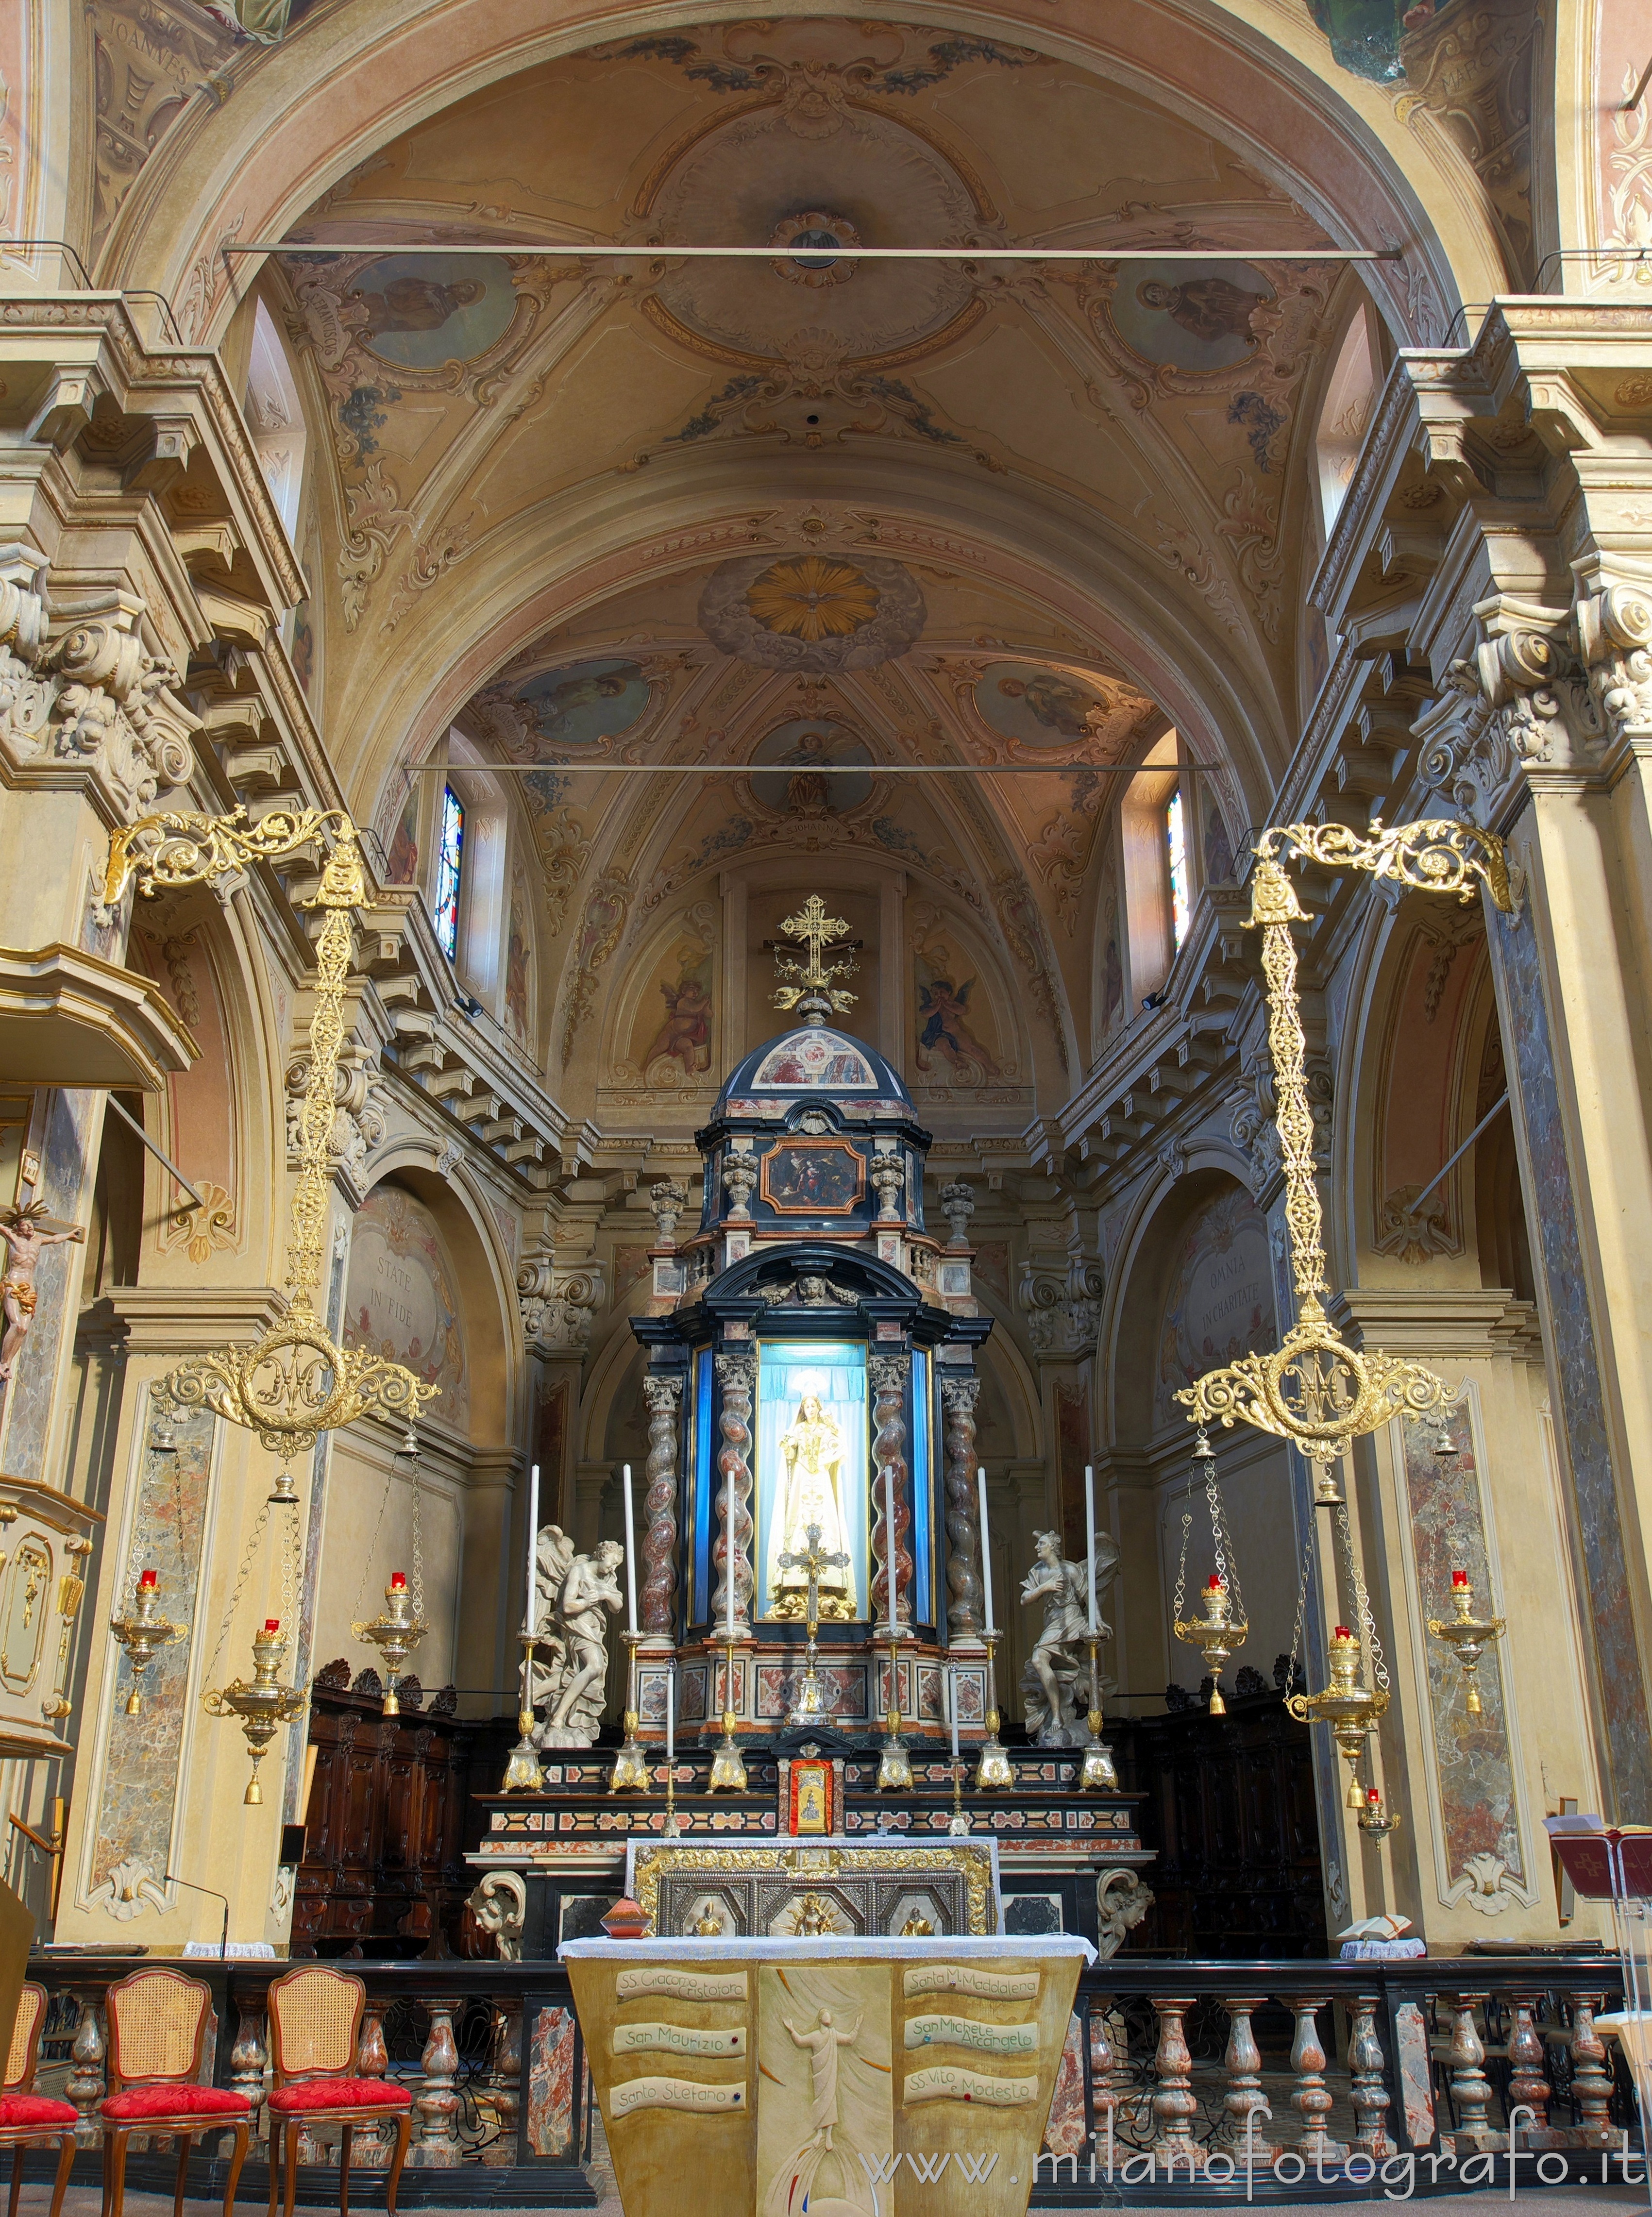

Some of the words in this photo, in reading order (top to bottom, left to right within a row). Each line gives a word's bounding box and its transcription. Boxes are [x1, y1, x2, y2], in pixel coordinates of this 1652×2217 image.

[106, 17, 190, 86] JOANNES
[1441, 27, 1517, 96] MARCVS
[377, 1257, 412, 1293] STATE
[1210, 1255, 1246, 1290] OMNIA
[371, 1288, 382, 1308] IN
[388, 1297, 412, 1328] FIDE
[1202, 1311, 1212, 1332] IN
[1213, 1282, 1259, 1322] CHARITATE
[641, 1971, 698, 1987] Giacomo
[677, 1981, 743, 1999] Cristoforo
[910, 1971, 944, 1990] Santa
[962, 1975, 1036, 1996] Maddalena
[625, 2031, 653, 2046] San
[658, 2027, 724, 2051] Maurizio
[913, 2020, 939, 2035] San
[940, 2017, 994, 2037] Michele
[961, 2031, 1032, 2052] Arcangelo
[927, 2069, 955, 2084] Vito
[619, 2083, 657, 2107] Santo
[662, 2083, 726, 2105] Stefano
[950, 2085, 958, 2094] e
[961, 2079, 1029, 2101] Modesto
